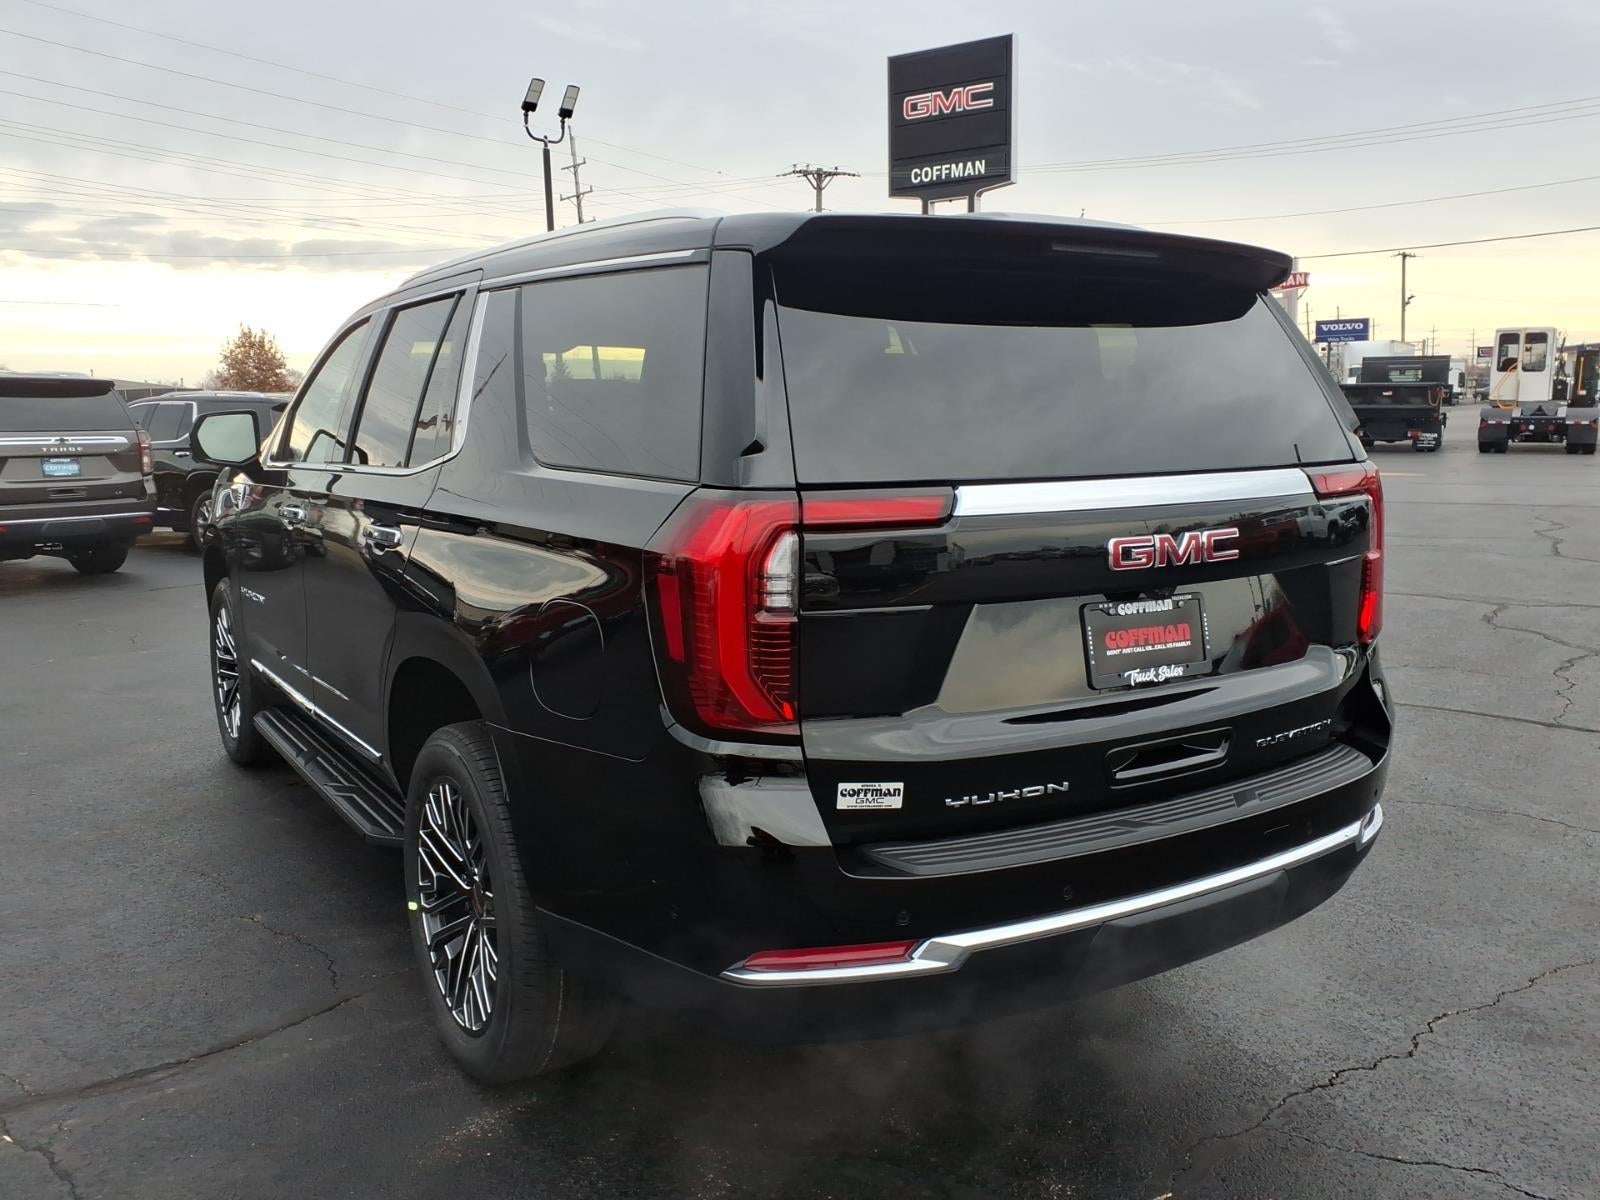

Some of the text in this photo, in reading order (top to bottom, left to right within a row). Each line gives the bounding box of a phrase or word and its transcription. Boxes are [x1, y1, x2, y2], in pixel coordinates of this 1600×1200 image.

[903, 82, 994, 120] GMC
[911, 160, 986, 184] COFFMAN
[1320, 322, 1364, 332] VOLVO
[1108, 527, 1240, 571] GMC
[1117, 599, 1173, 616] COFFMAN
[1105, 623, 1191, 650] COFFMAN
[1124, 664, 1184, 687] Truck Sales
[840, 787, 902, 798] COFFMAN
[945, 781, 1069, 808] YUKON
